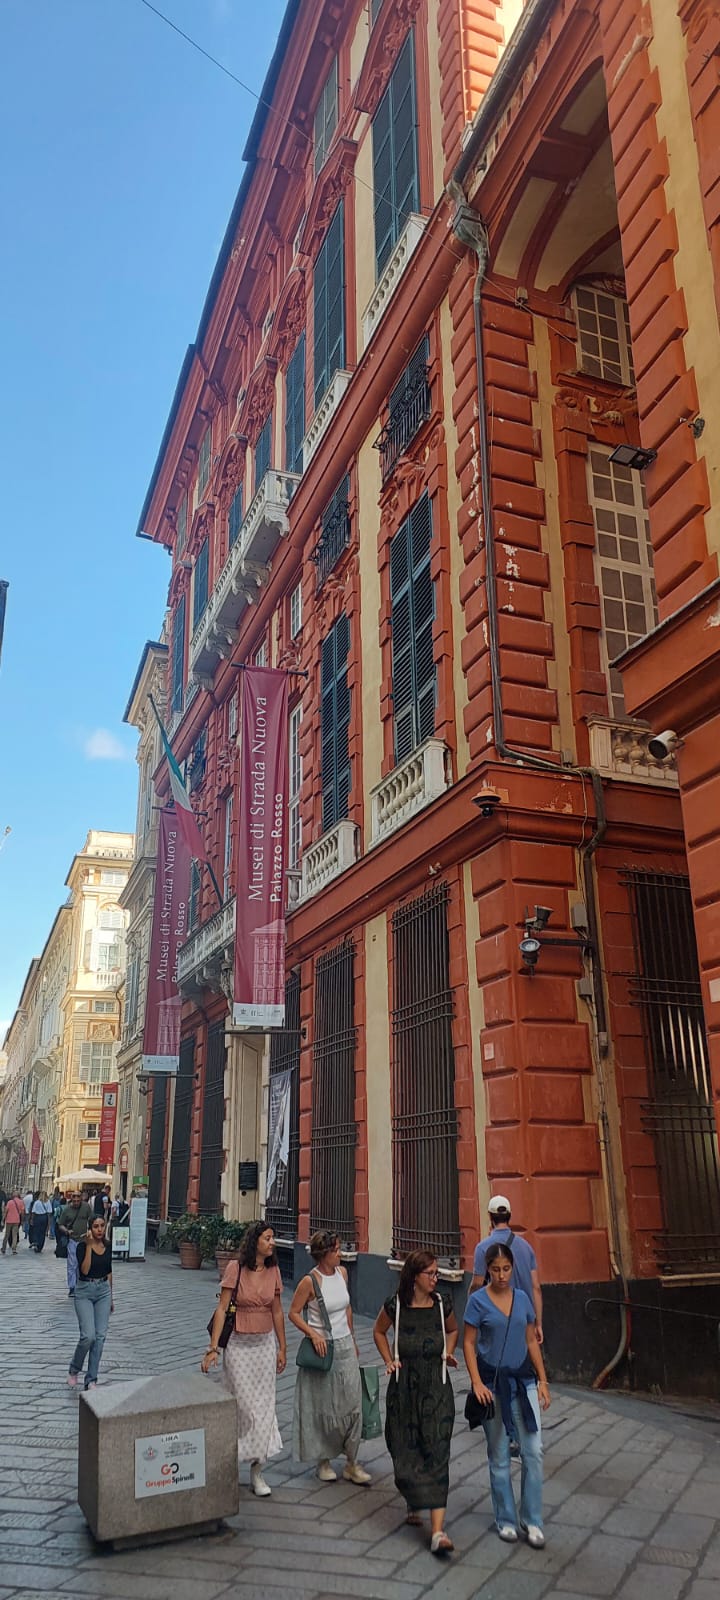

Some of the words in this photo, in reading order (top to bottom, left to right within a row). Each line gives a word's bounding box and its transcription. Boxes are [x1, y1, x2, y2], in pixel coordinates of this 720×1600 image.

[251, 696, 267, 755] Nuova
[249, 761, 265, 817] Strada
[249, 823, 265, 839] di
[271, 793, 284, 838] Rosso
[163, 830, 177, 873] Nuova
[248, 846, 264, 902] Musei
[269, 845, 283, 903] Palazzo
[160, 878, 174, 919] Strada
[174, 902, 186, 936] Rosso
[159, 923, 171, 936] di
[155, 940, 171, 982] Musei
